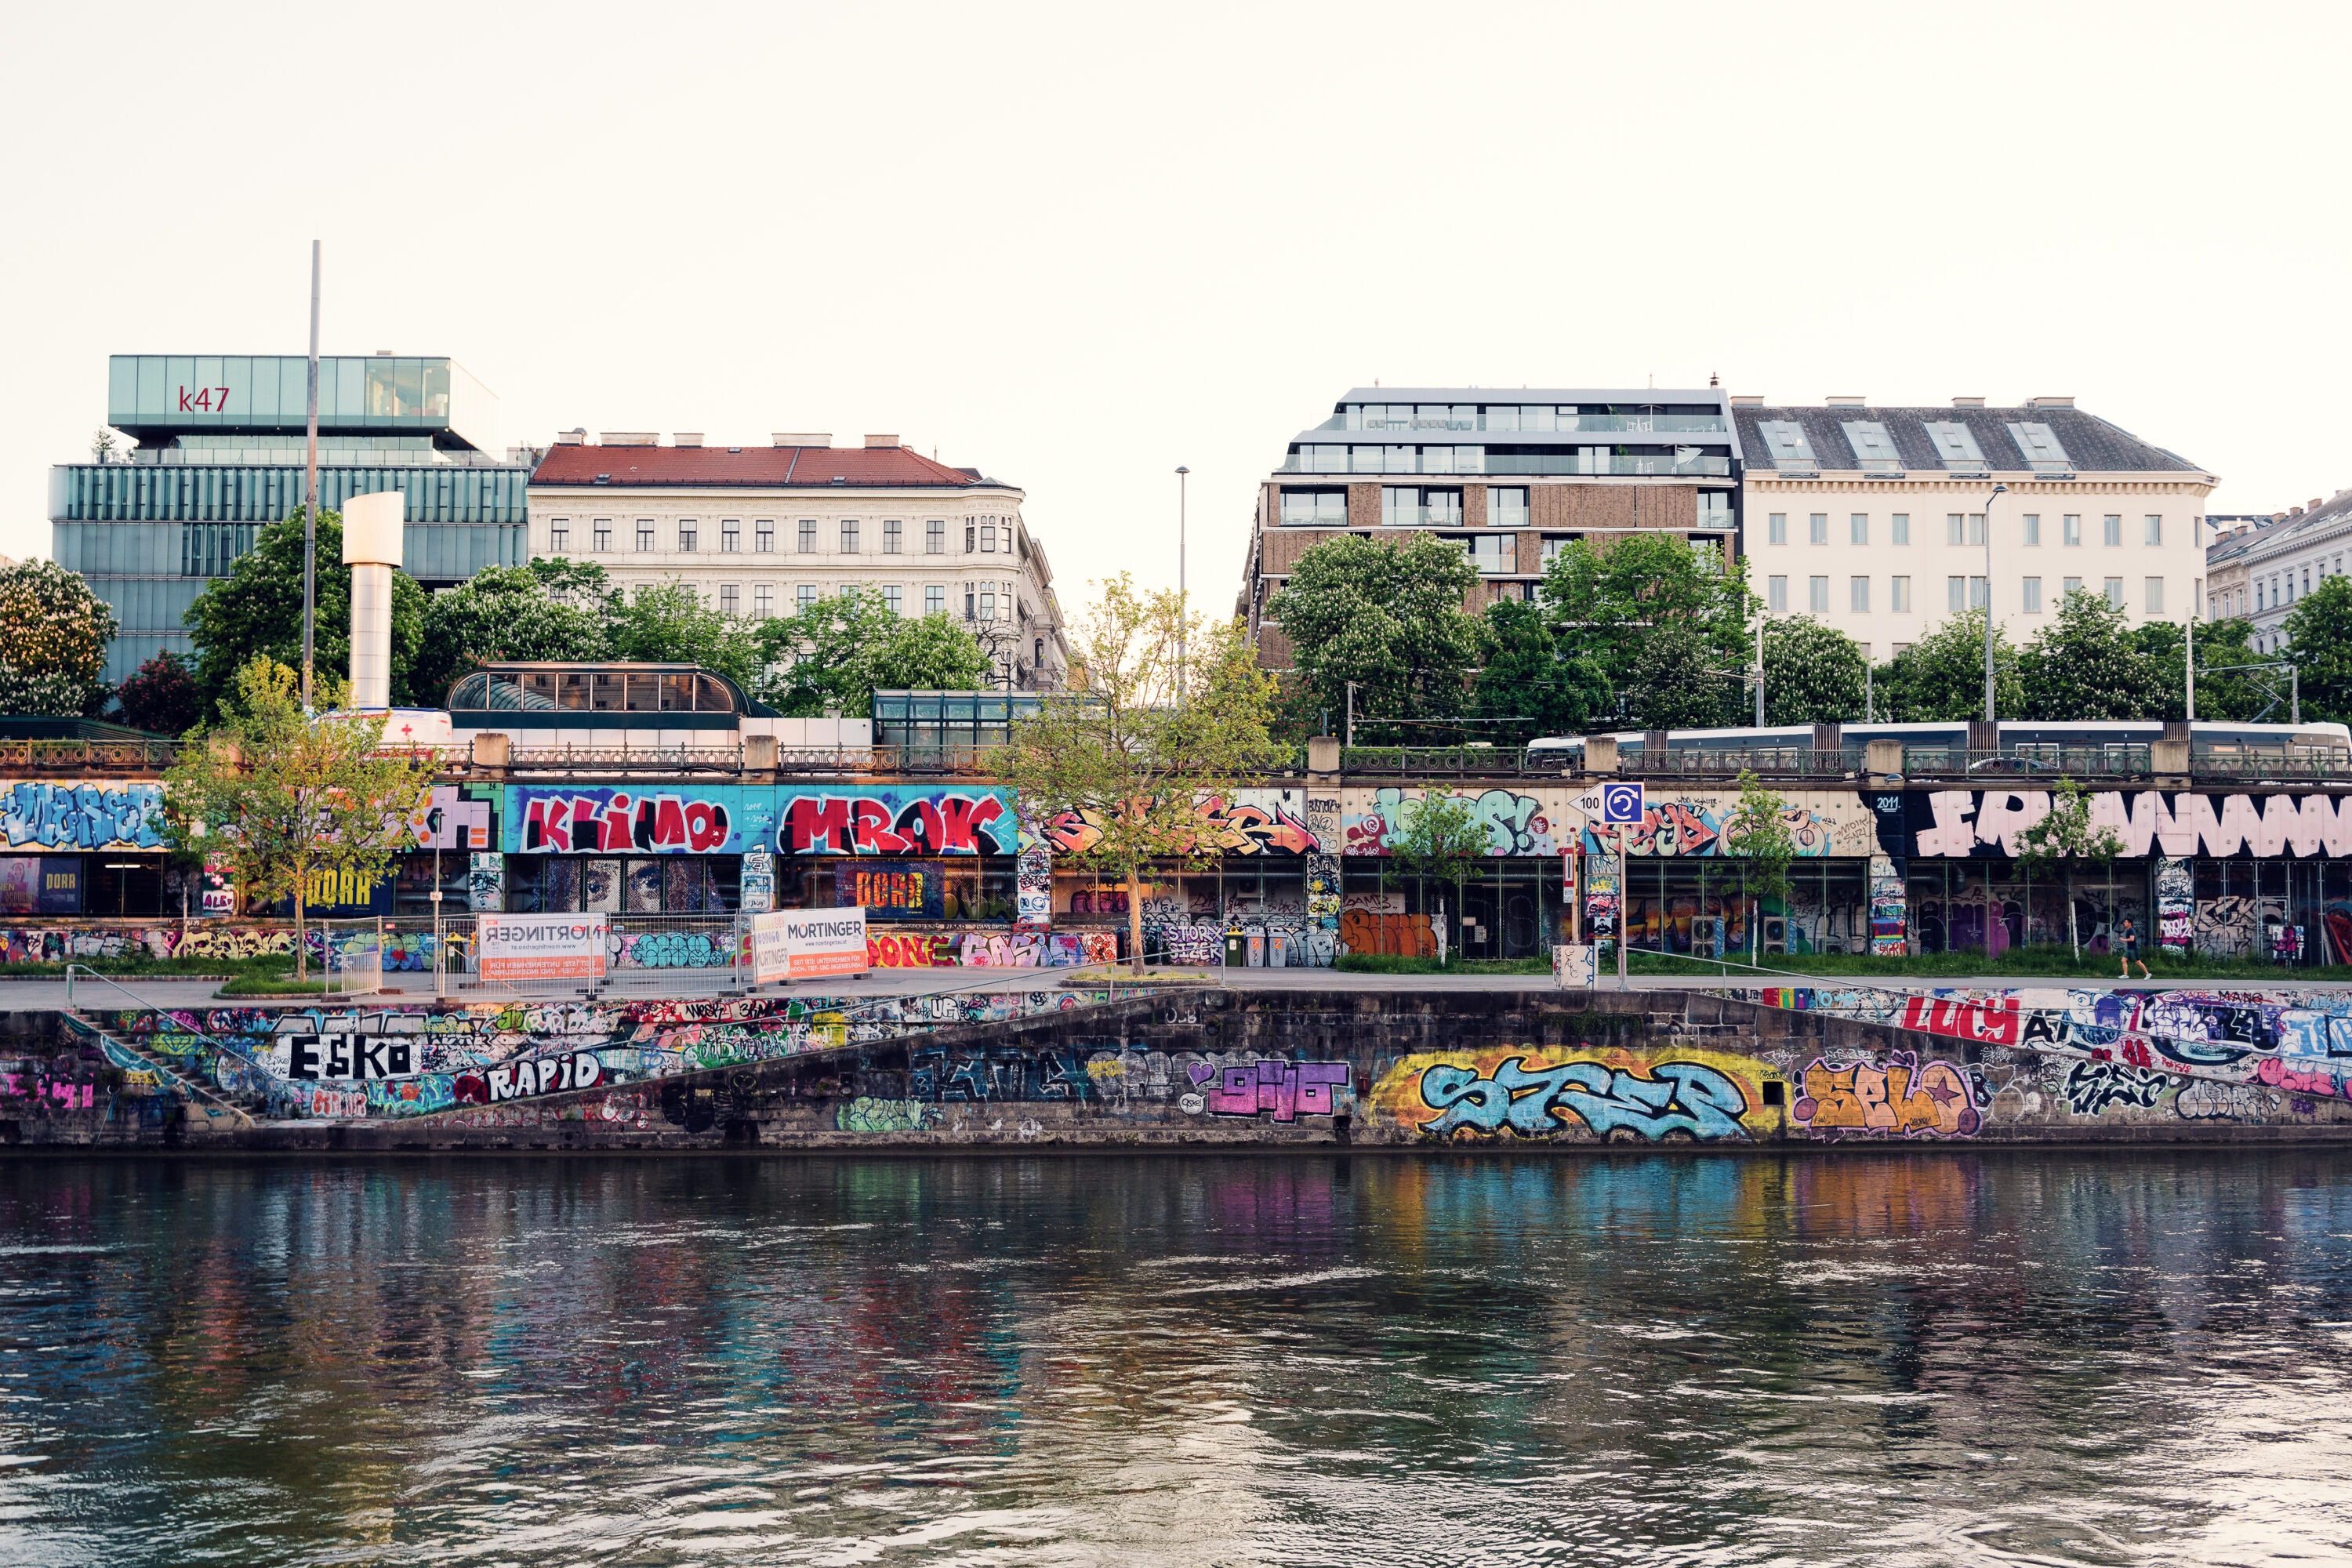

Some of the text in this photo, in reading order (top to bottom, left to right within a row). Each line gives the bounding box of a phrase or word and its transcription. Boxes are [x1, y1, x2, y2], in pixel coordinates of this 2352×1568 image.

[179, 385, 230, 412] k47
[1580, 797, 1599, 809] 100
[205, 894, 227, 908] ALE
[289, 1034, 411, 1080] ESKO
